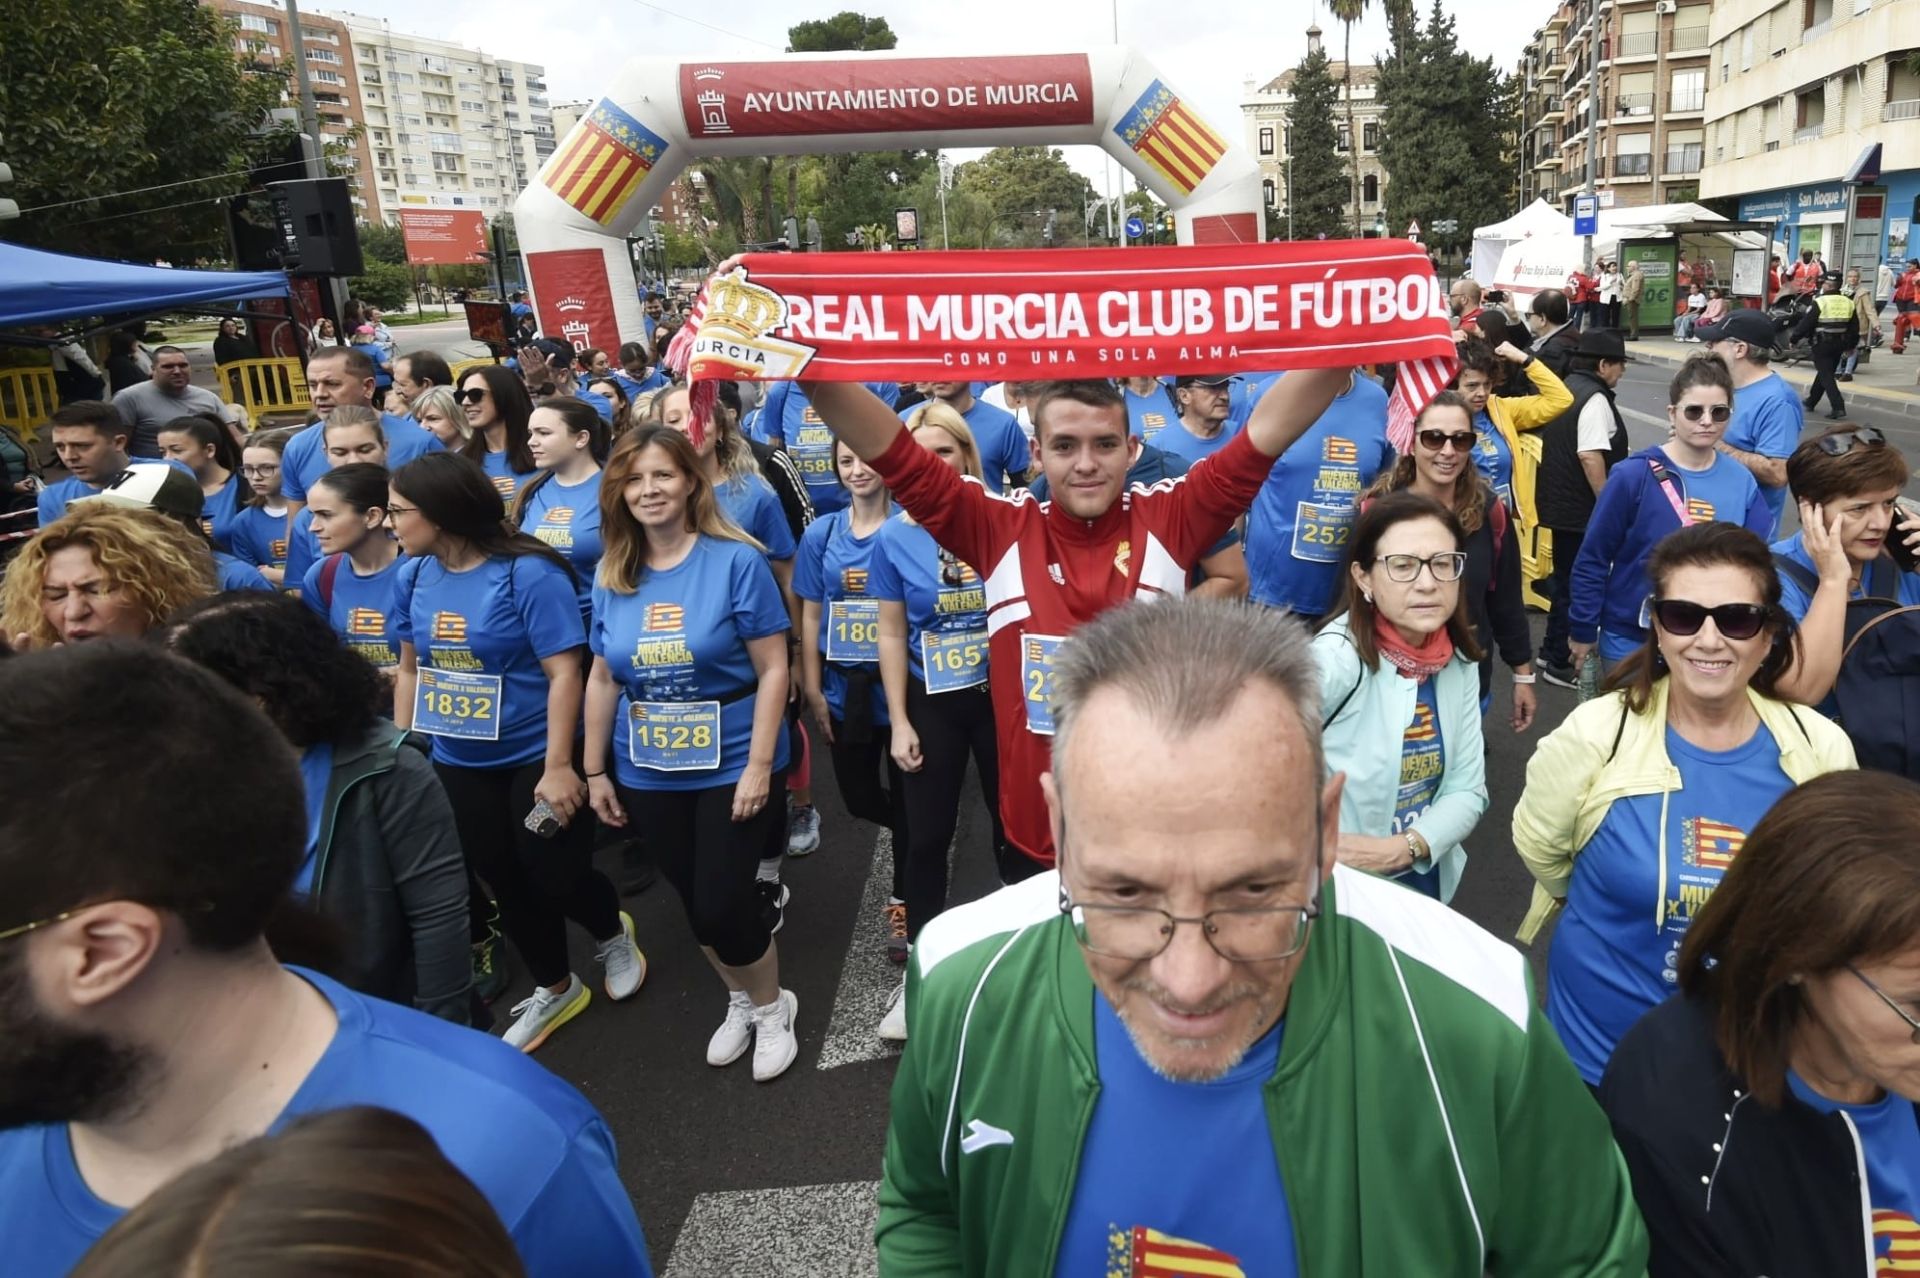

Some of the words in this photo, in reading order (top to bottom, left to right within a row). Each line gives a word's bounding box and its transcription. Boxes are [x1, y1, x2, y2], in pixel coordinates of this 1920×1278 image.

[743, 87, 939, 113] AYUNTAMIENTO
[947, 86, 978, 107] DE
[985, 83, 1079, 106] MURCIA
[1798, 192, 1812, 207] San
[1814, 189, 1839, 208] Roque
[778, 294, 899, 341] REAL
[906, 290, 1090, 341] MURCIA
[1097, 288, 1214, 338] CLUB
[1224, 284, 1280, 333] DE
[1290, 269, 1449, 331] FÚTBOL
[943, 351, 1008, 366] COMO
[1031, 350, 1076, 364] UNA
[1099, 347, 1156, 362] SOLA
[1179, 345, 1239, 361] ALMA
[836, 622, 878, 643] 180
[631, 654, 639, 666] X
[640, 650, 694, 667] VALENCIA
[424, 690, 491, 719] 1832
[637, 725, 712, 749] 1528
[1667, 899, 1680, 916] X
